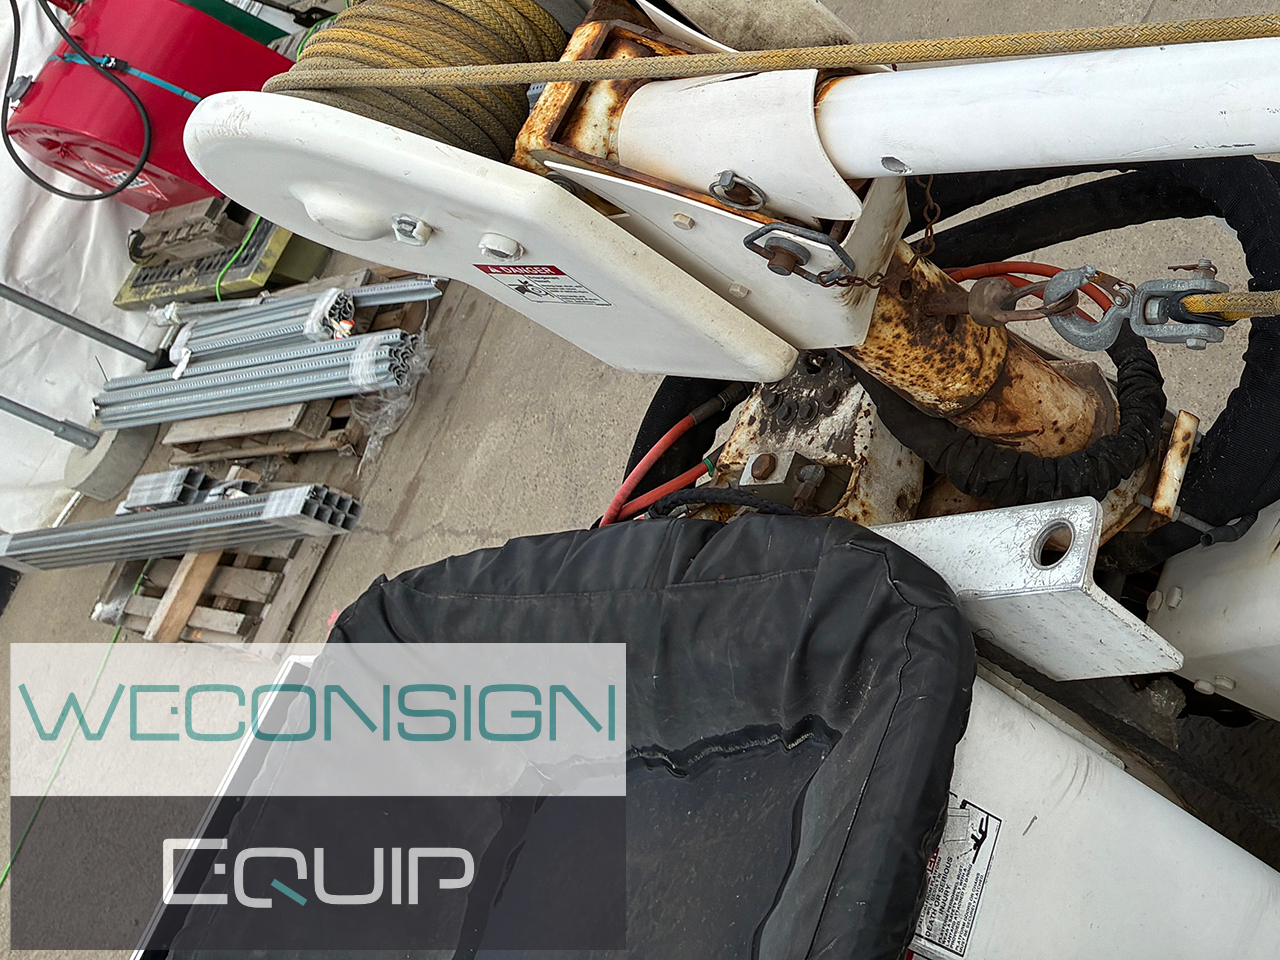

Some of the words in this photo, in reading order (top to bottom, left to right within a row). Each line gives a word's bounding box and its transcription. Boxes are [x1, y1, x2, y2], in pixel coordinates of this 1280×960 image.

[501, 267, 556, 275] DANGER
[924, 907, 937, 937] DEATH
[933, 893, 941, 907] OR
[937, 855, 952, 893] SERIOUS
